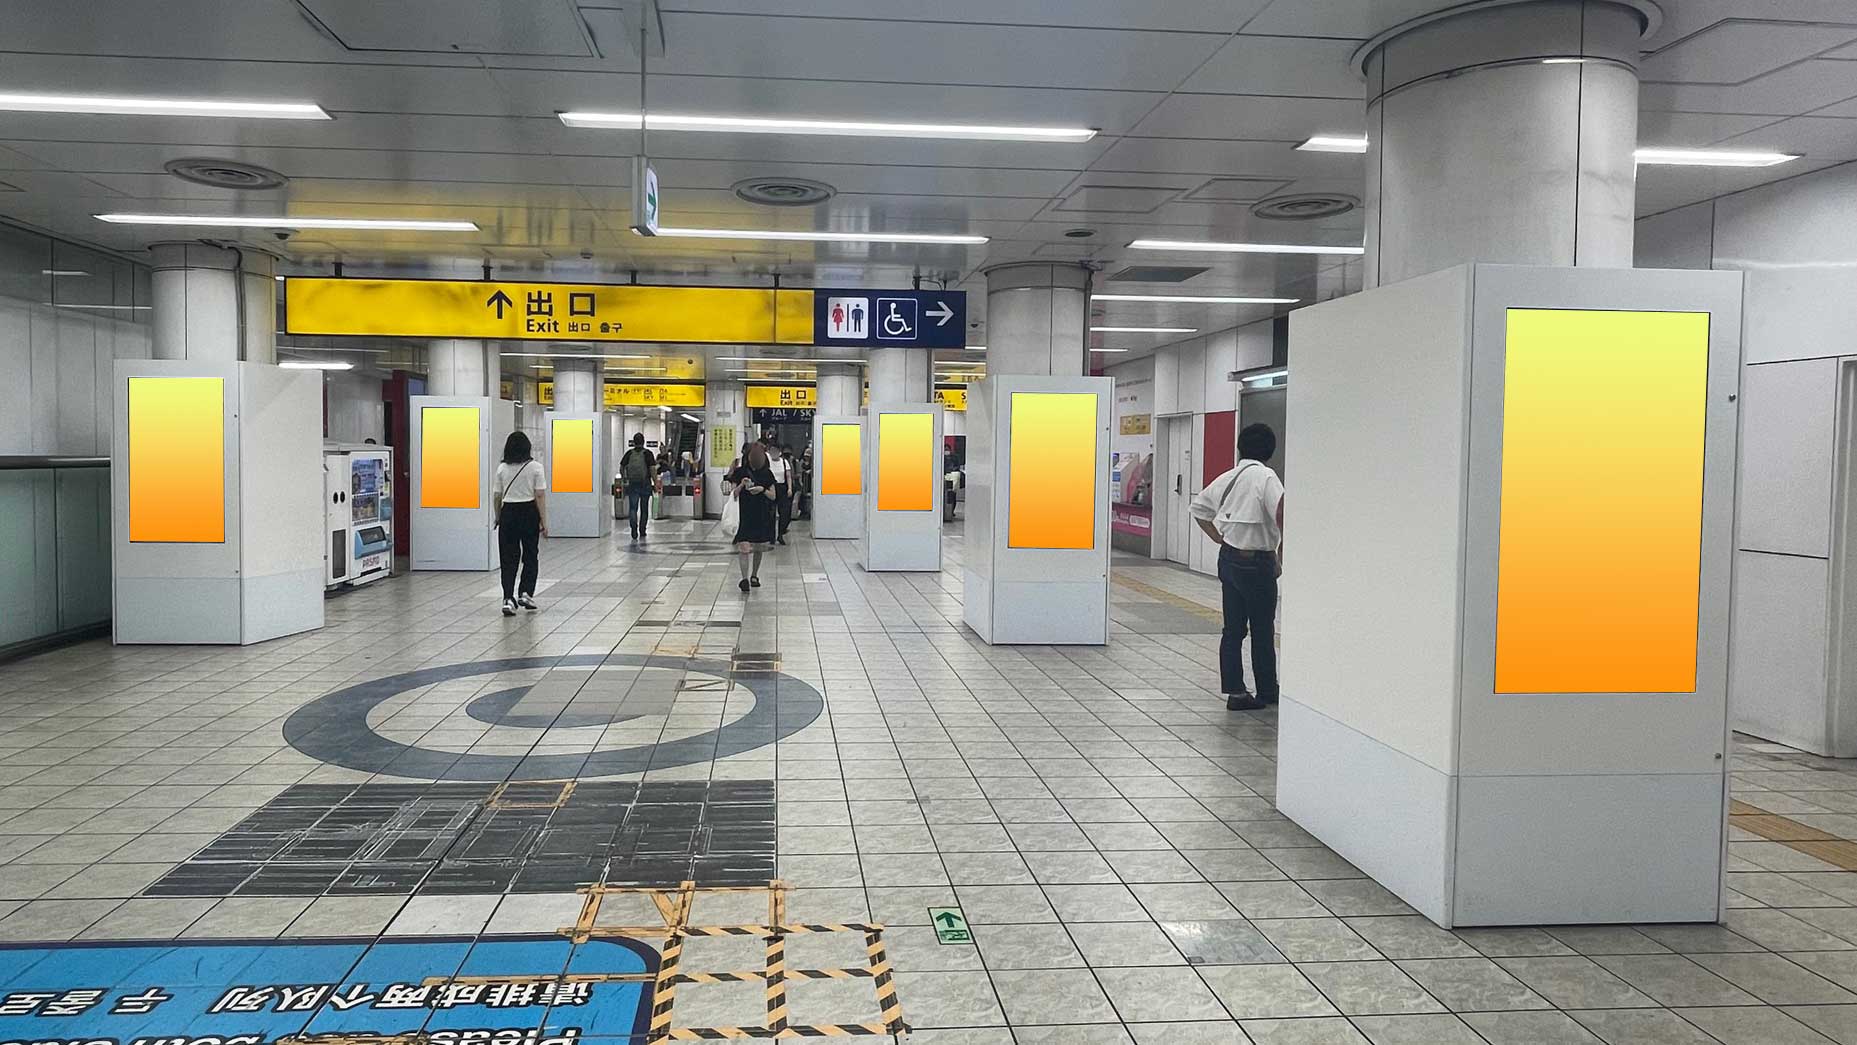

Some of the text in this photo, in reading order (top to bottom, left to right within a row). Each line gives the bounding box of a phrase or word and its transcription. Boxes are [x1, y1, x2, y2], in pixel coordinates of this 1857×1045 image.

[526, 290, 596, 317] 出口
[526, 319, 560, 333] Exit
[568, 322, 591, 333] 出口
[780, 389, 807, 400] 出口
[771, 408, 788, 417] JAL
